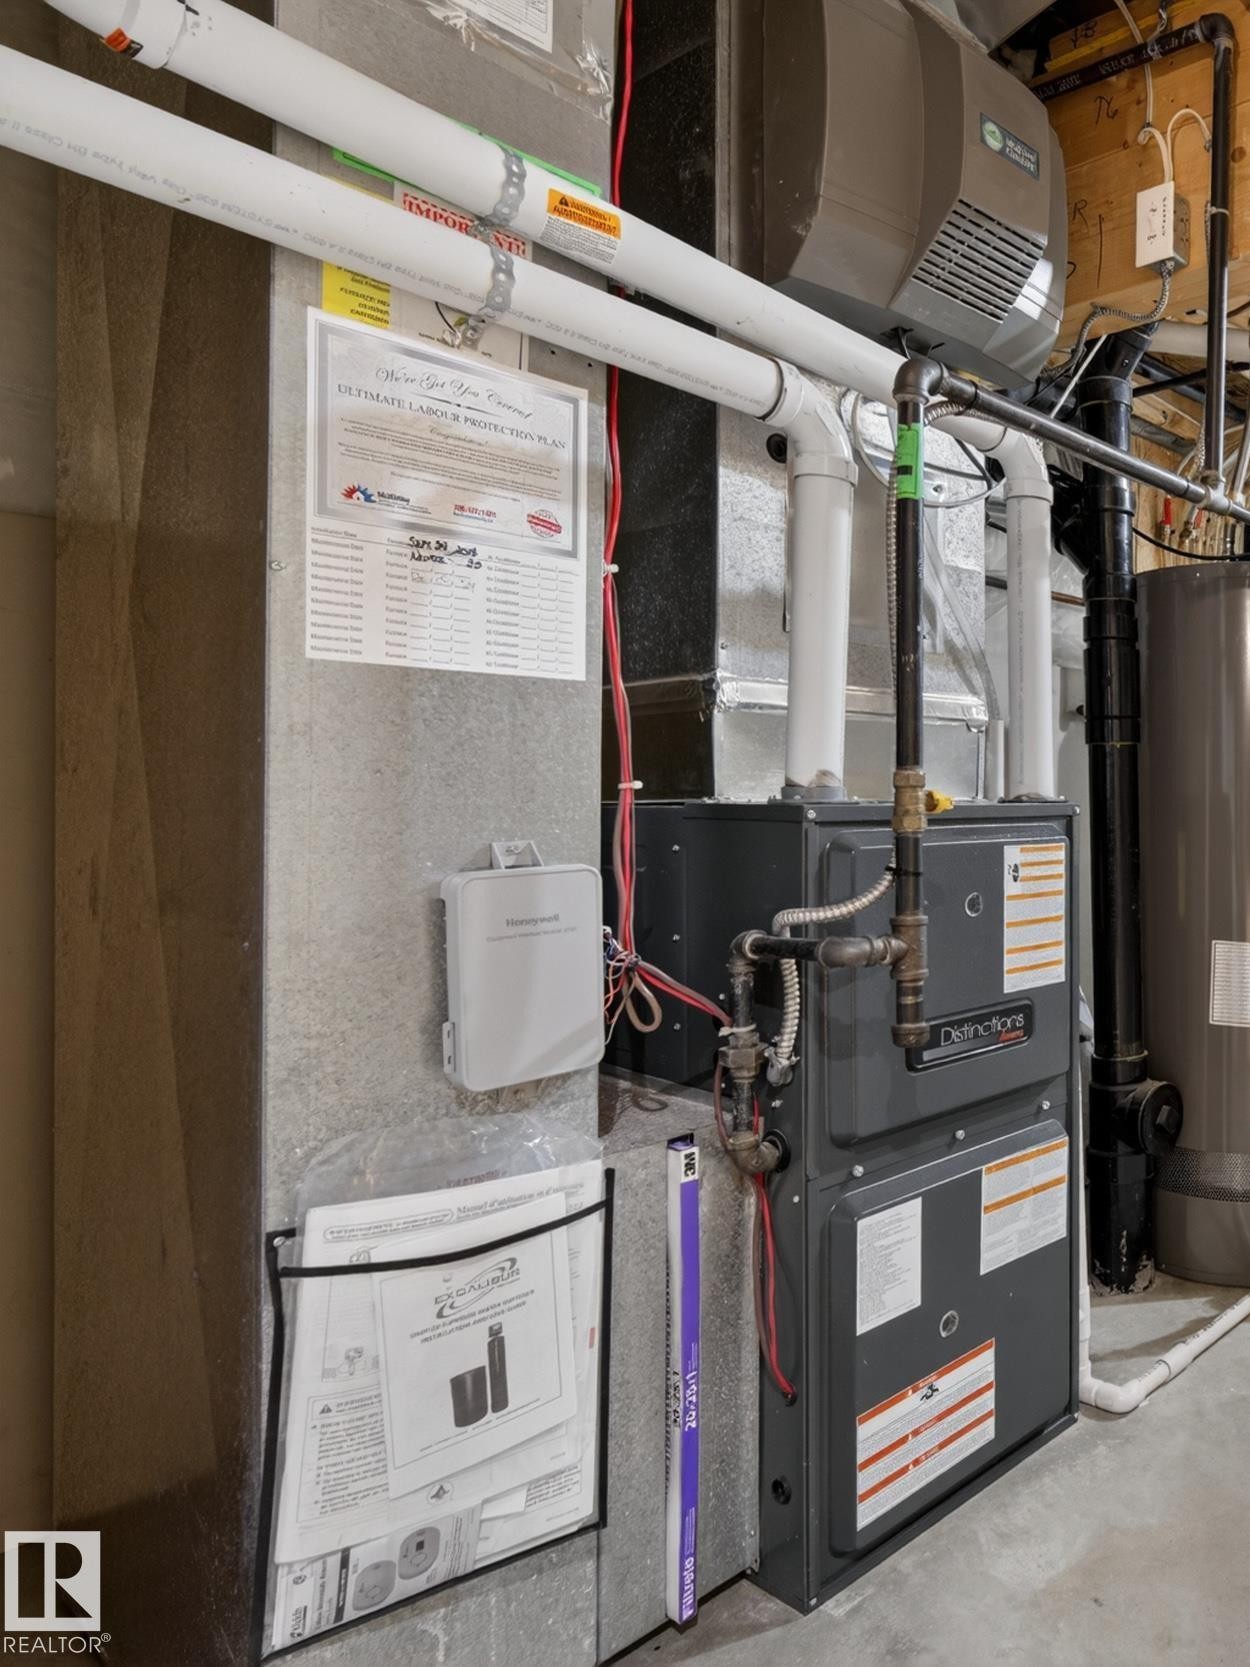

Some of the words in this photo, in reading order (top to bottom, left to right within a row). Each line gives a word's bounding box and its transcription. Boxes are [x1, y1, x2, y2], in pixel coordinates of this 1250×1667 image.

[337, 383, 406, 410] ULTIMATE
[408, 400, 462, 424] LABOUR
[463, 415, 535, 442] PROTECTION
[536, 434, 567, 450] PLAN
[505, 913, 560, 928] Honeywell
[940, 1013, 1025, 1046] Distinctions
[684, 1151, 696, 1177] 3M
